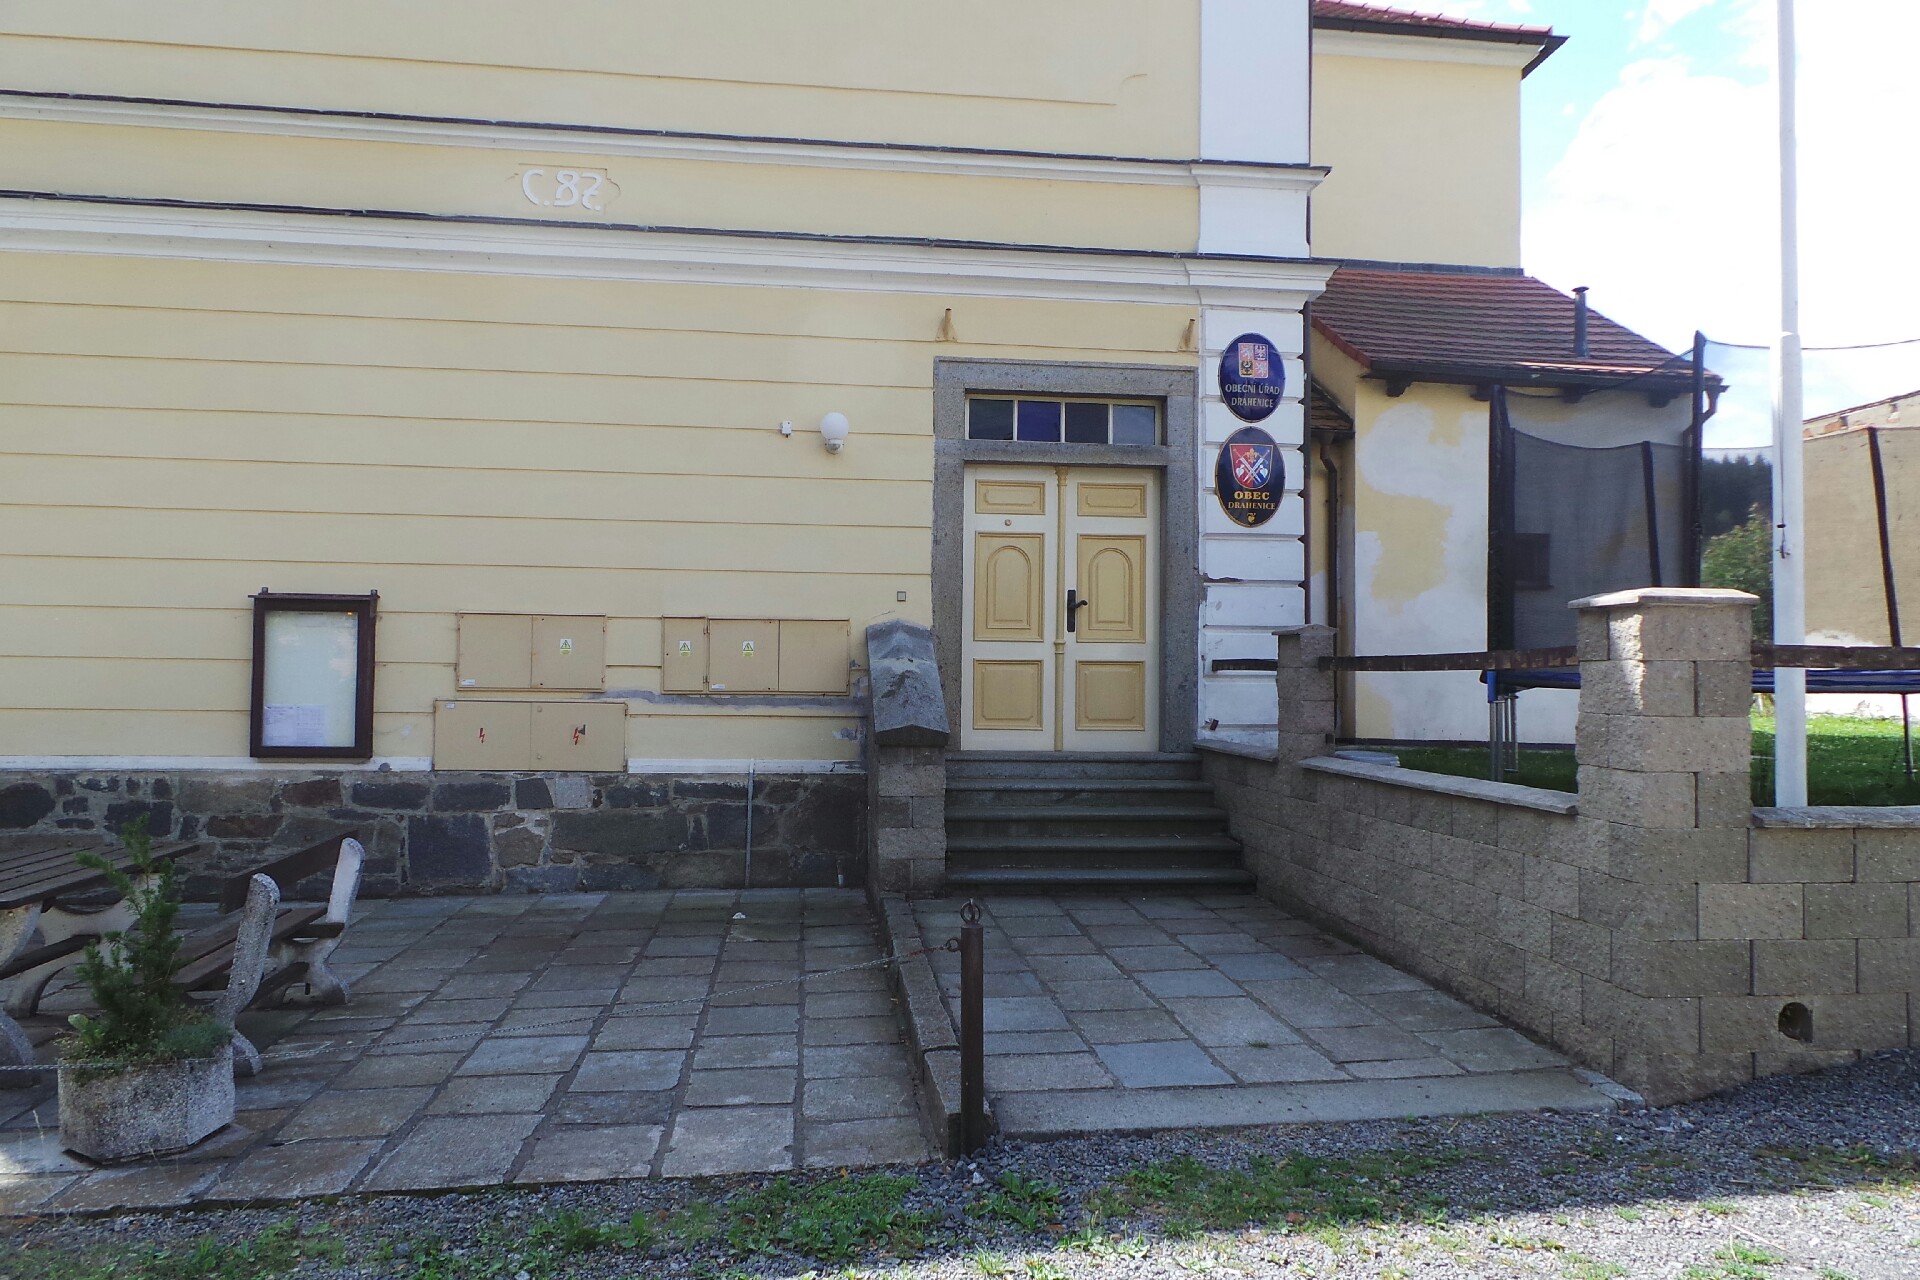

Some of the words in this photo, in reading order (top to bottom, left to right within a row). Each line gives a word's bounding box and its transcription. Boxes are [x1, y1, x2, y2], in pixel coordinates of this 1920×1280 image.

[1225, 383, 1256, 394] OBECNÍ
[1258, 383, 1280, 395] ÚŘAD
[1231, 397, 1274, 408] DRAHENICE
[1233, 490, 1270, 500] OBEC
[1228, 501, 1276, 510] DRAHENICE
